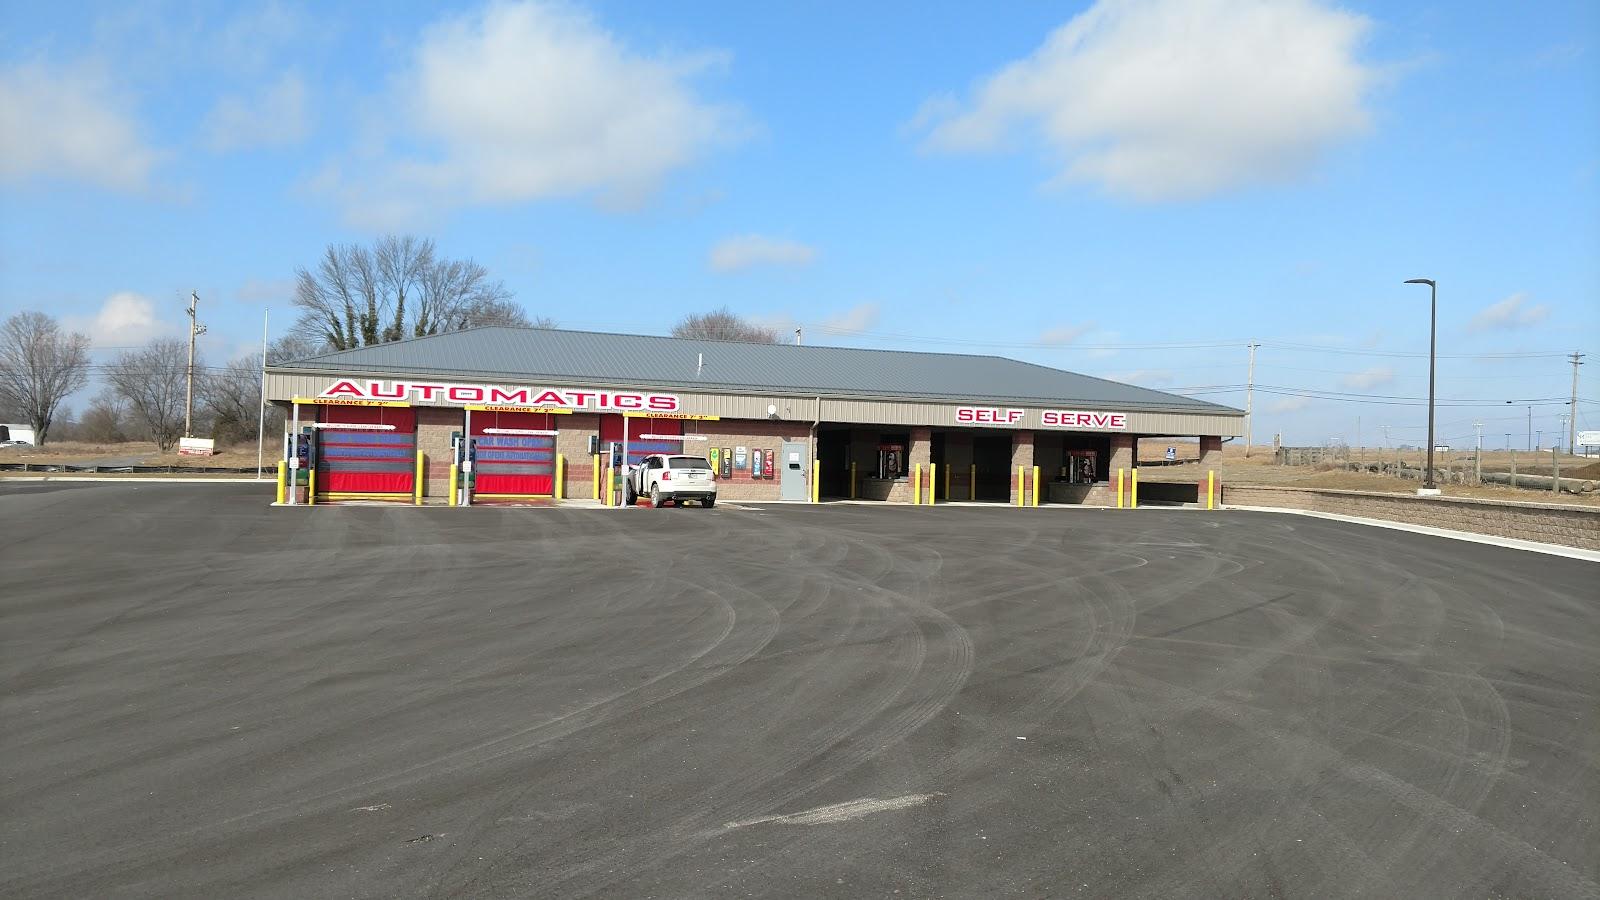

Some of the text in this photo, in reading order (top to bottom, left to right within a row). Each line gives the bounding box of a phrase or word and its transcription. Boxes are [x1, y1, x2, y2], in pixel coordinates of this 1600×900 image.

[324, 380, 677, 411] AUTOMATICS
[957, 408, 1125, 427] SELF SERVE
